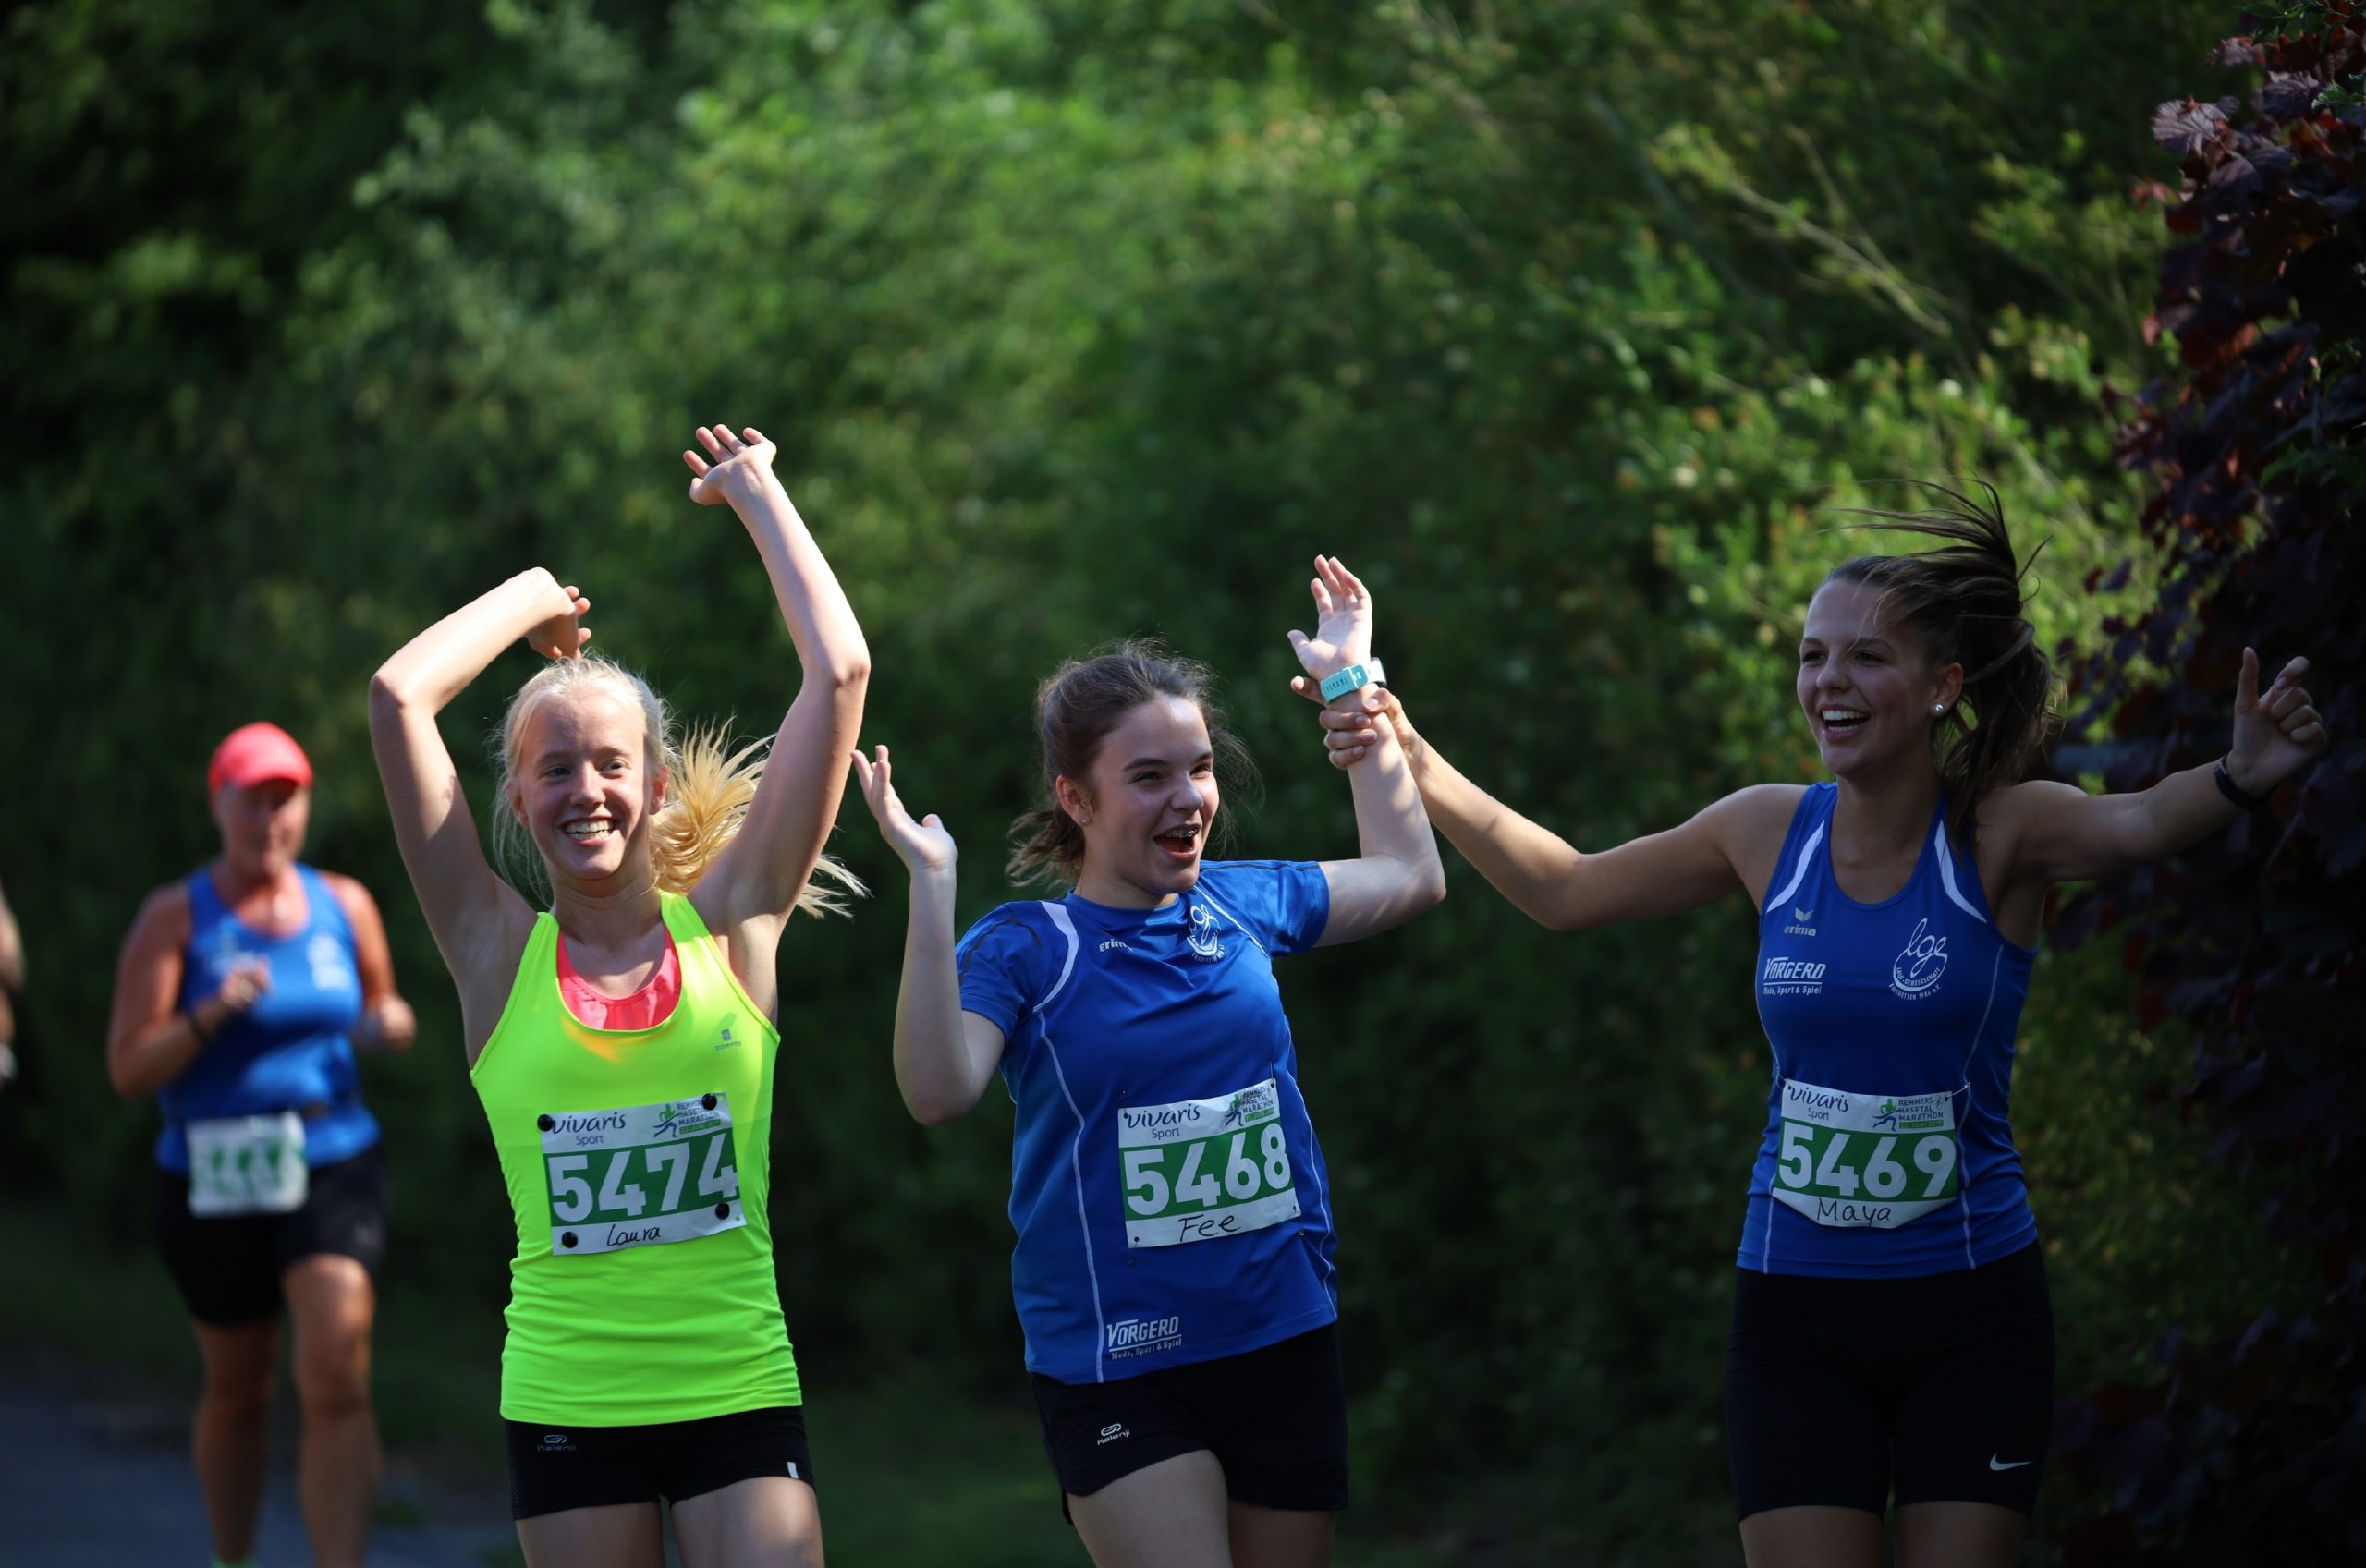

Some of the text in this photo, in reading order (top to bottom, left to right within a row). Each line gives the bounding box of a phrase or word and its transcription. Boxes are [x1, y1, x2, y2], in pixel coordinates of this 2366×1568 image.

[1783, 924, 1817, 937] erima
[1777, 986, 1794, 996] Sport
[1802, 986, 1823, 996] Spiel
[1790, 1086, 1849, 1112] vivaris
[1898, 1096, 1933, 1106] REMMERS
[1898, 1105, 1934, 1113] HASETAL
[552, 1111, 627, 1135] vivaris
[1128, 1102, 1201, 1129] vivaris
[1808, 1107, 1830, 1121] Sport
[1898, 1112, 1944, 1121] MARATHON
[575, 1133, 604, 1147] Sport
[1151, 1126, 1180, 1141] Sport
[1123, 1122, 1291, 1216] 5468
[1778, 1120, 1957, 1199] 5469
[547, 1132, 738, 1222] 5474
[1816, 1197, 1892, 1227] Maya
[606, 1223, 662, 1247] Laura
[1177, 1213, 1242, 1243] Fee
[1112, 1337, 1182, 1361] Mode, Sport & Spiel
